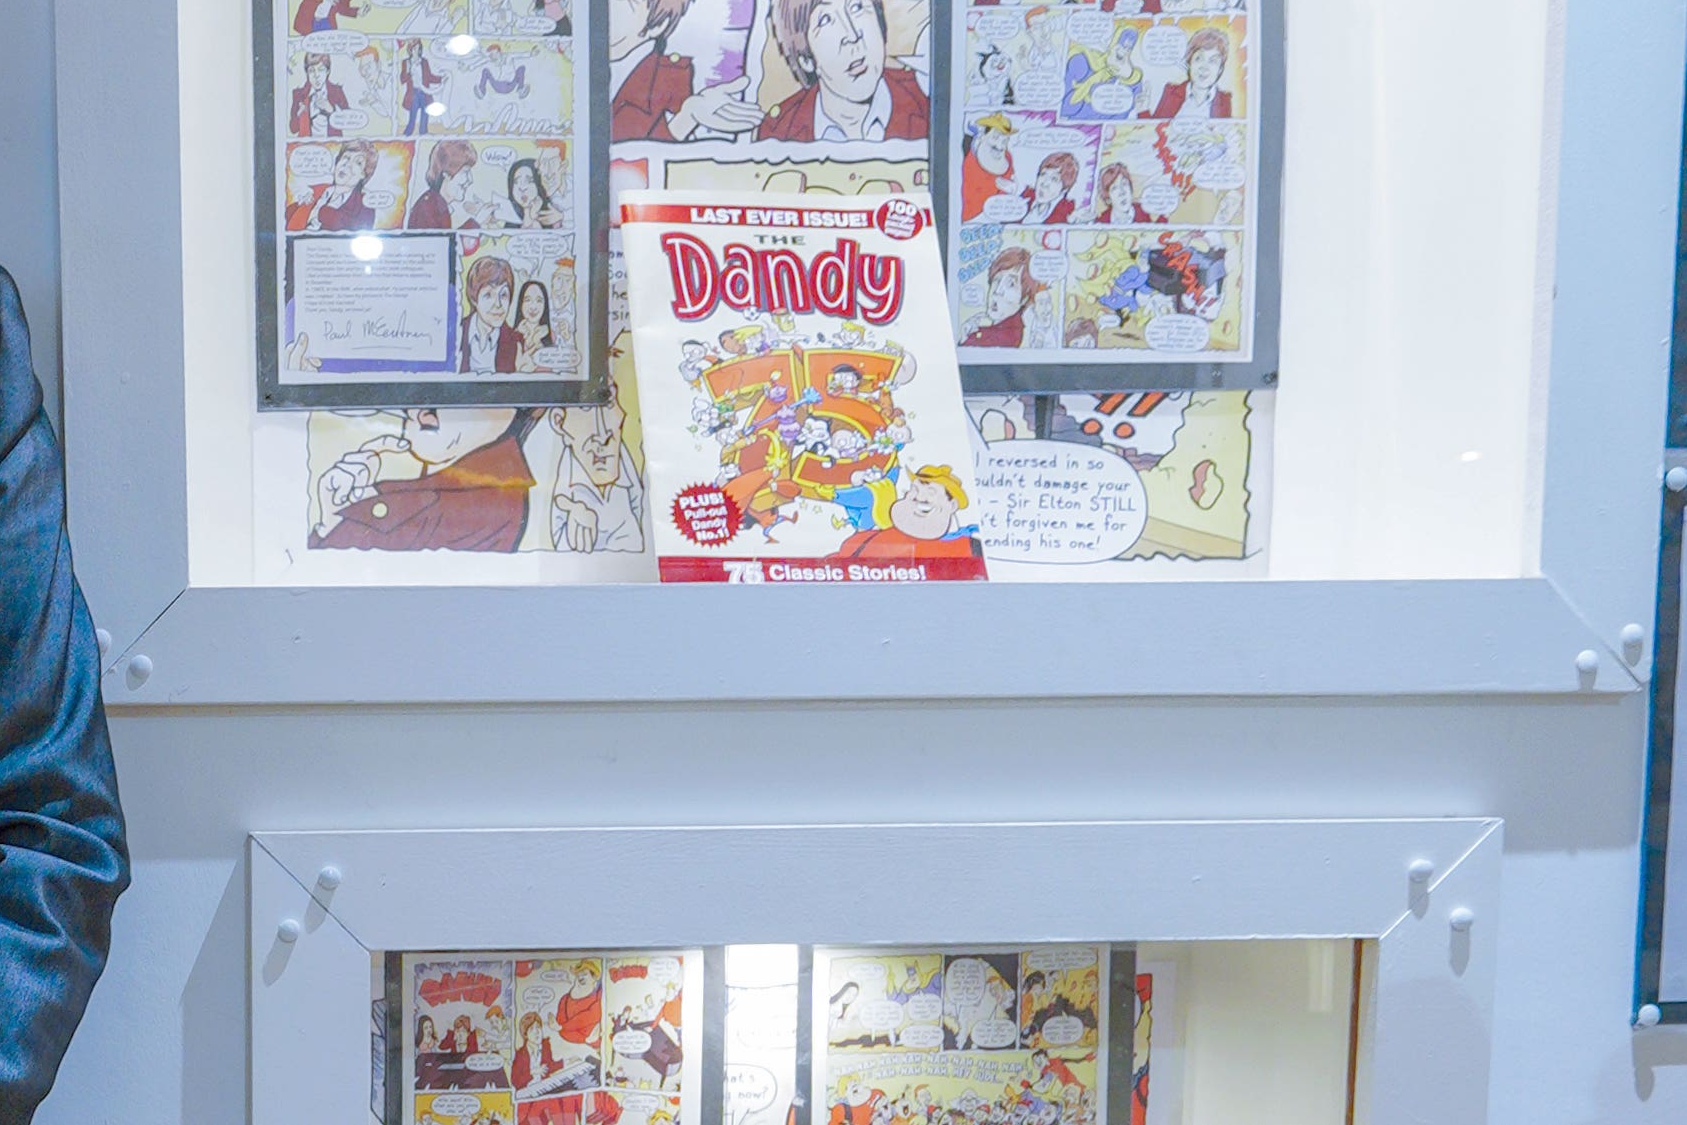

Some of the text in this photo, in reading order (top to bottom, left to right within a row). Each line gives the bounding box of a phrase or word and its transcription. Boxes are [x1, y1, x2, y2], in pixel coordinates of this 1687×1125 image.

[690, 207, 869, 228] LAST EVER ISSUE!
[887, 201, 918, 218] 100
[754, 234, 806, 246] THE
[661, 232, 906, 327] Dandy
[988, 454, 1058, 469] reversed
[1066, 454, 1080, 469] in
[1087, 460, 1105, 471] so
[1033, 474, 1090, 494] damage
[1097, 482, 1132, 497] your
[679, 491, 726, 510] PLUS!
[1006, 492, 1031, 509] Sir
[1038, 493, 1082, 511] Elton
[1089, 495, 1138, 513] STILL
[684, 505, 728, 521] Pull-out
[1005, 510, 1068, 533] forgiven
[1075, 520, 1096, 531] me
[1103, 513, 1128, 532] for
[691, 517, 728, 531] Dandy
[1039, 534, 1062, 550] his
[1068, 535, 1102, 551] one!
[722, 561, 928, 585] 75 Classic Stories!
